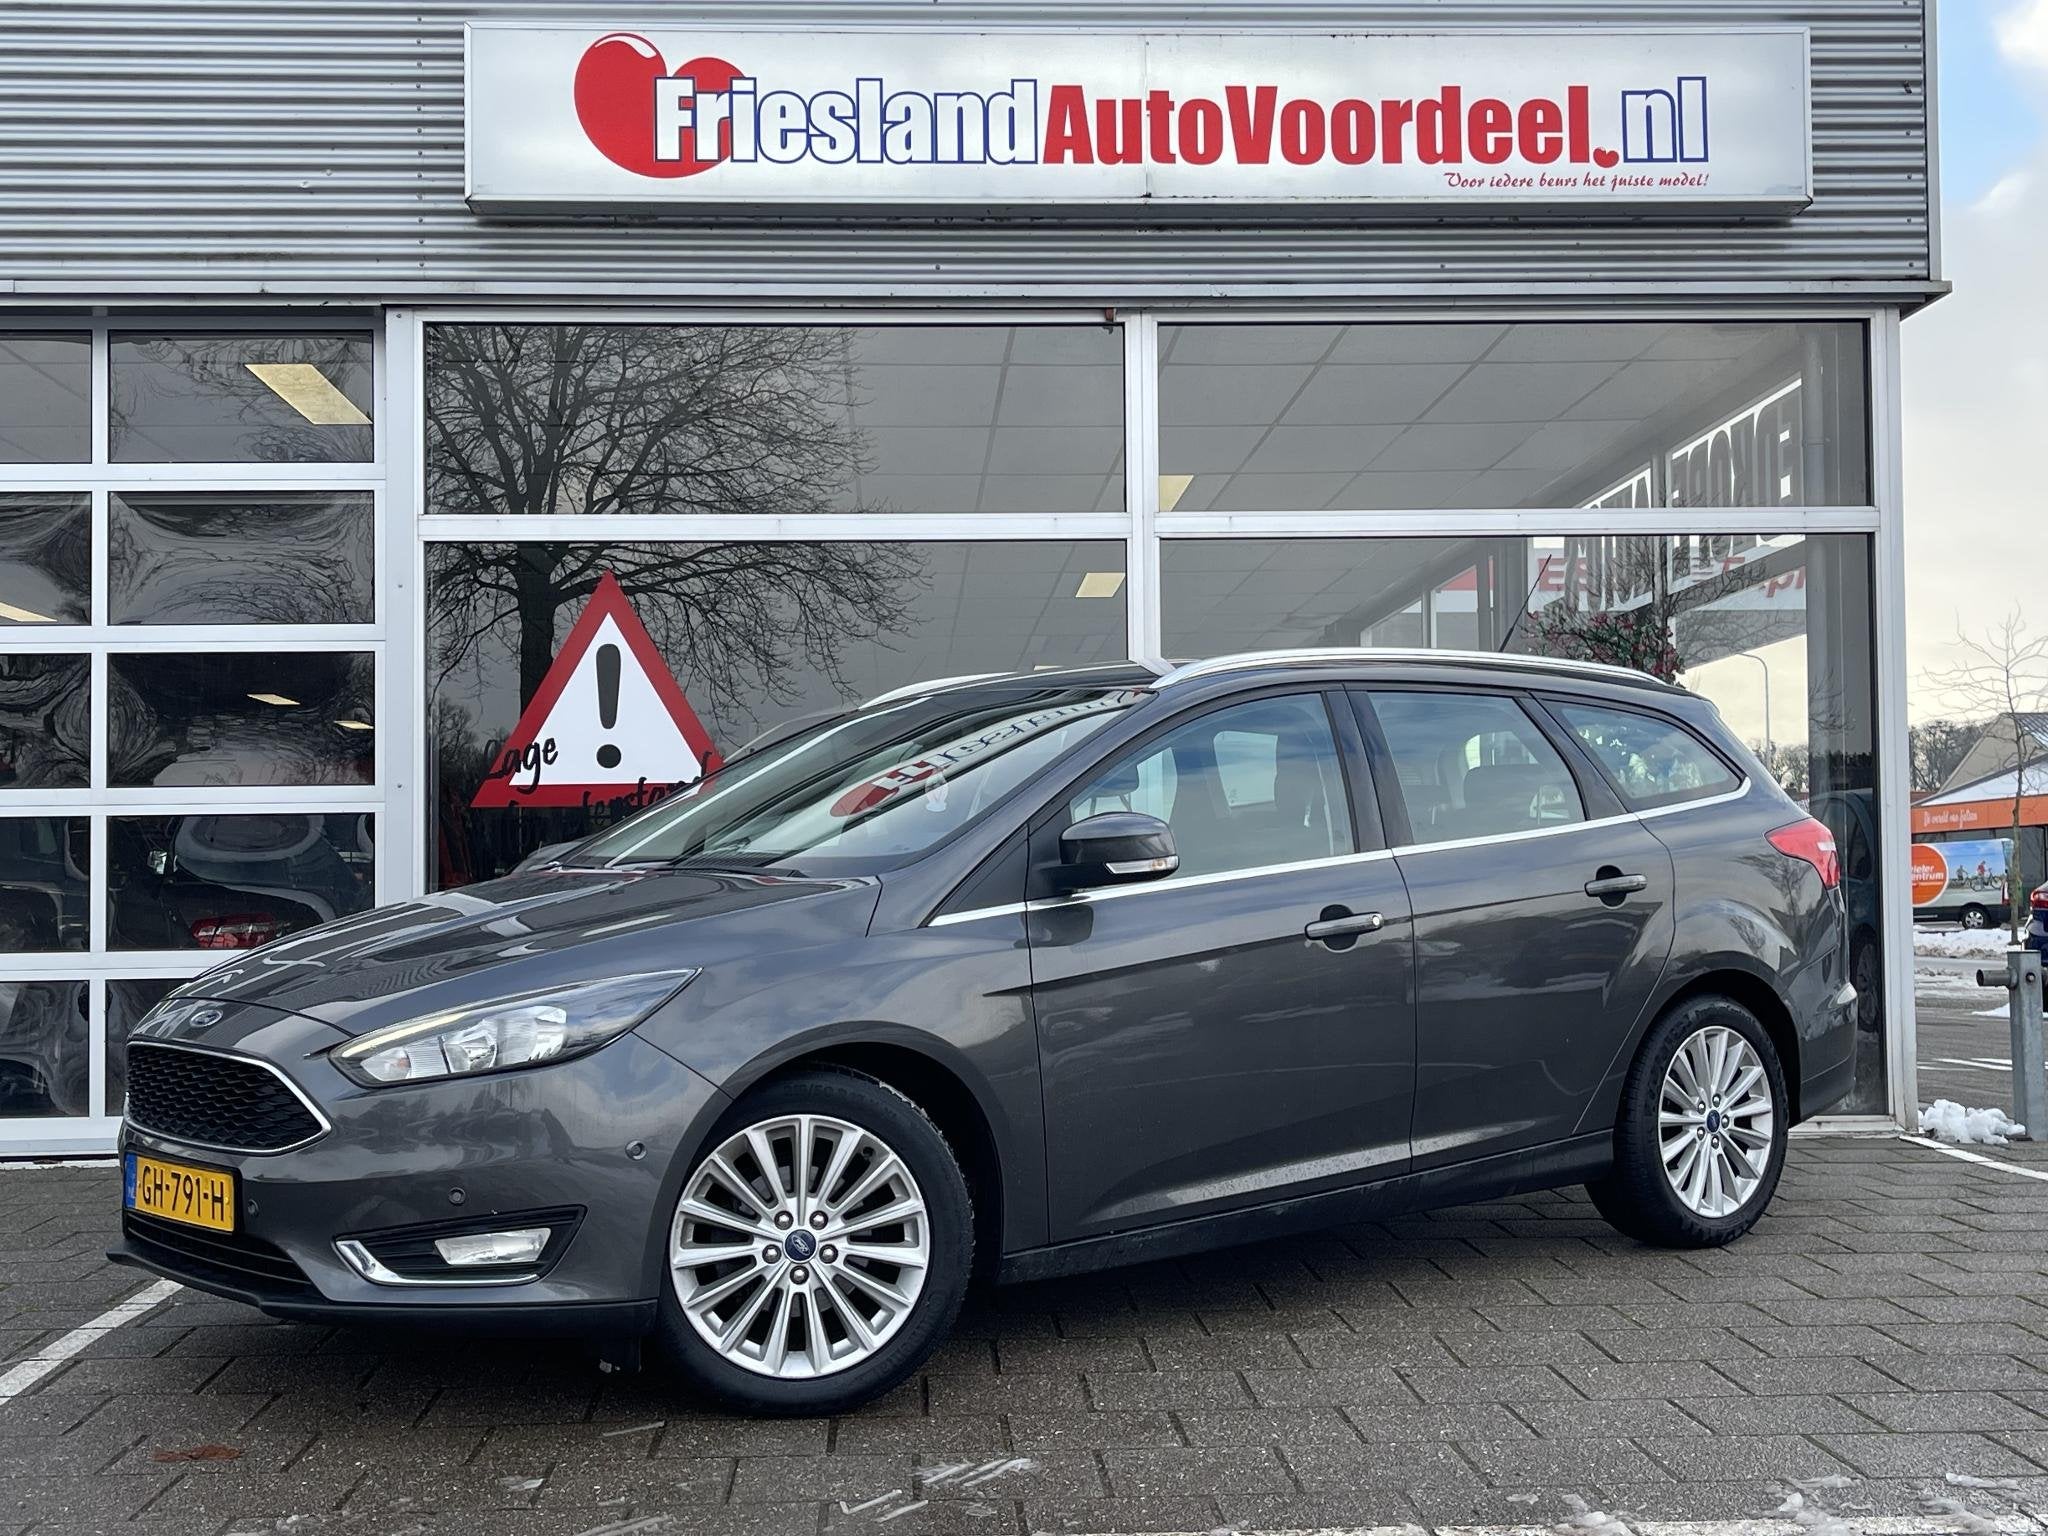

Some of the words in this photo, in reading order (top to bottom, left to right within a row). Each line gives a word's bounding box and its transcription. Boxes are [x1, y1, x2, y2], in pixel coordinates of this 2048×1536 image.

[1443, 172, 1485, 188] Voor
[1489, 172, 1534, 188] iedere
[1539, 172, 1577, 188] beurs
[1583, 172, 1606, 187] het
[1611, 172, 1653, 191] juiste
[1659, 172, 1709, 188] model!
[482, 738, 558, 794] Lage
[1911, 872, 1944, 881] entrum
[142, 1165, 225, 1222] GH-791-H
